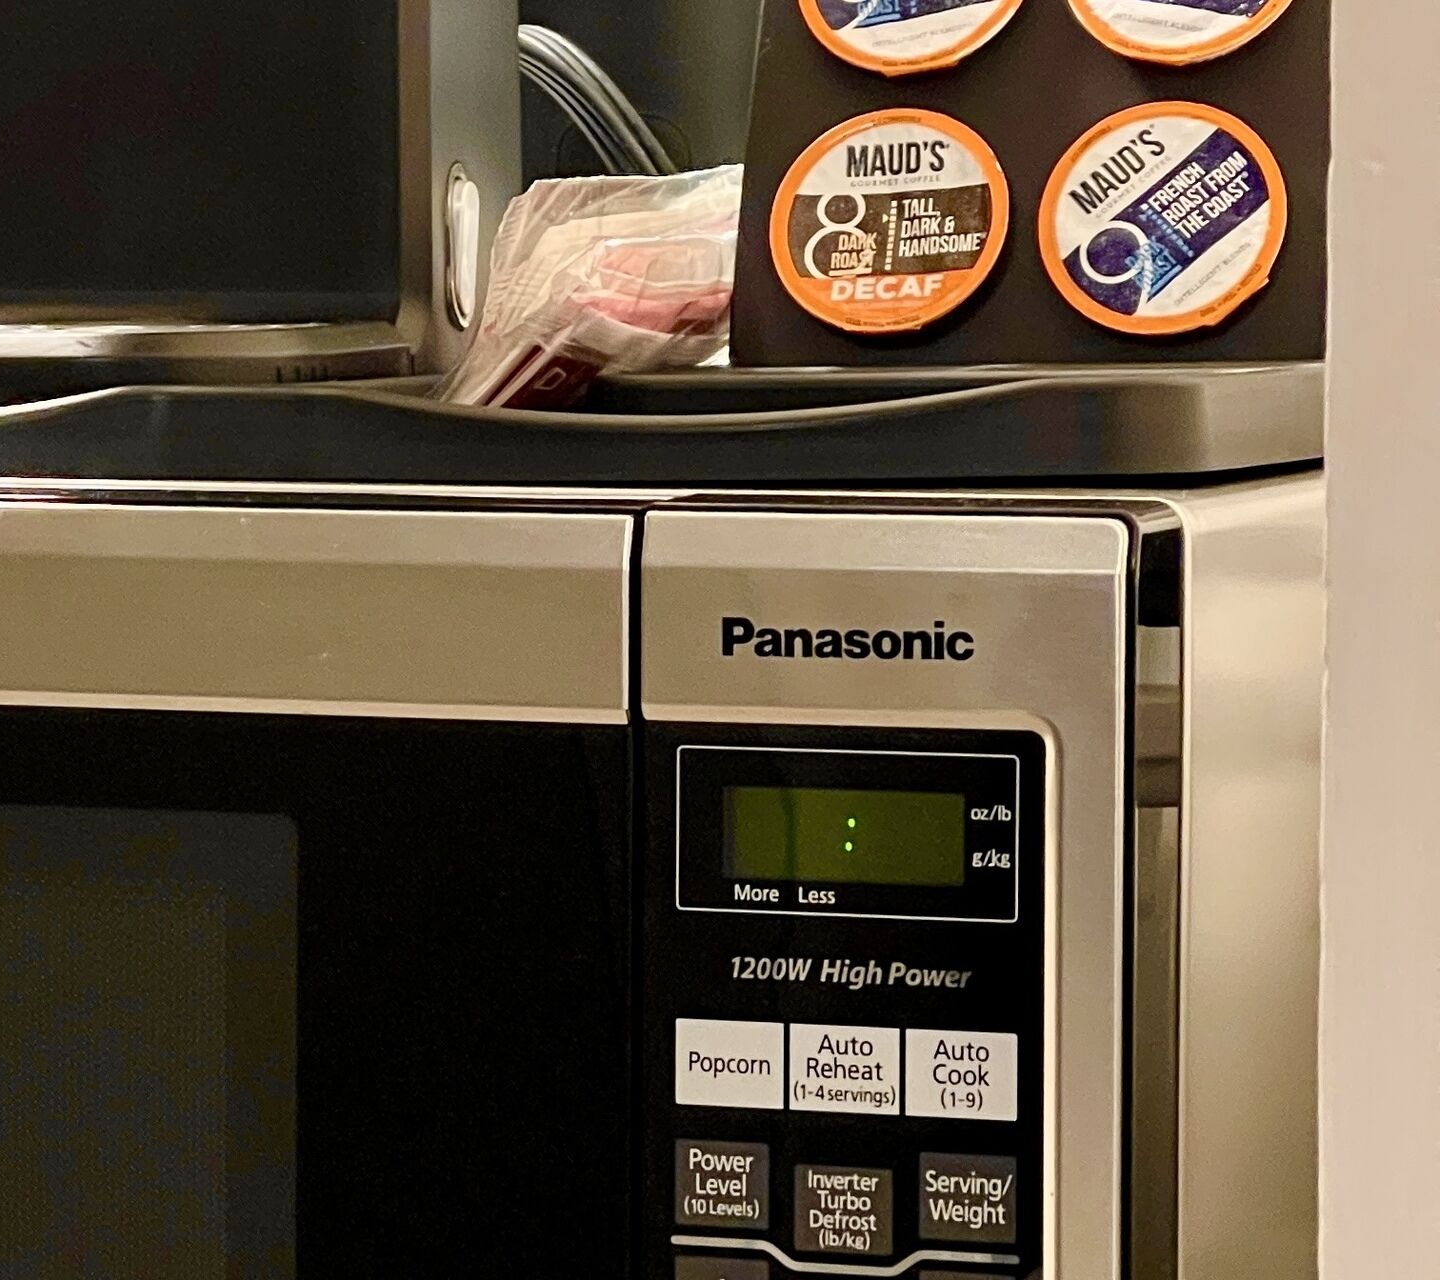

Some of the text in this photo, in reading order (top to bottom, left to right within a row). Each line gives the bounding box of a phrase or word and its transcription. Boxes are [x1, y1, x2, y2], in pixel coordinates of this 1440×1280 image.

[845, 140, 946, 178] MAUD'S
[1068, 128, 1166, 215] MAUD'S
[1148, 161, 1207, 212] FRENCH
[1162, 150, 1248, 227] ROAST FROM
[902, 198, 941, 219] TALL,
[900, 216, 956, 238] DARK &
[1174, 207, 1210, 239] THE
[838, 232, 878, 251] DARK
[898, 234, 982, 258] HANDSOME
[830, 251, 877, 269] ROAST
[830, 274, 945, 302] DECAF
[721, 616, 975, 661] Panasonic
[970, 804, 1012, 822] oz/lb
[971, 848, 1012, 869] g/kg
[733, 883, 836, 904] More Less
[731, 956, 972, 990] 1200W High Power
[817, 1033, 874, 1057] Auto
[933, 1039, 990, 1063] Auto
[688, 1051, 771, 1079] Popcorn
[806, 1057, 883, 1082] Reheat
[932, 1064, 990, 1088] Cook
[939, 1089, 984, 1111] (1-9)
[688, 1147, 754, 1174] Power
[695, 1172, 747, 1197] Level
[807, 1169, 879, 1192] Inverter
[924, 1169, 1013, 1202] Serving/
[683, 1195, 760, 1220] (10 Levels)
[816, 1189, 872, 1212] Turbo
[809, 1209, 877, 1232] Defrost
[928, 1198, 1006, 1229] Weight
[818, 1229, 871, 1252] (lb/kg)
